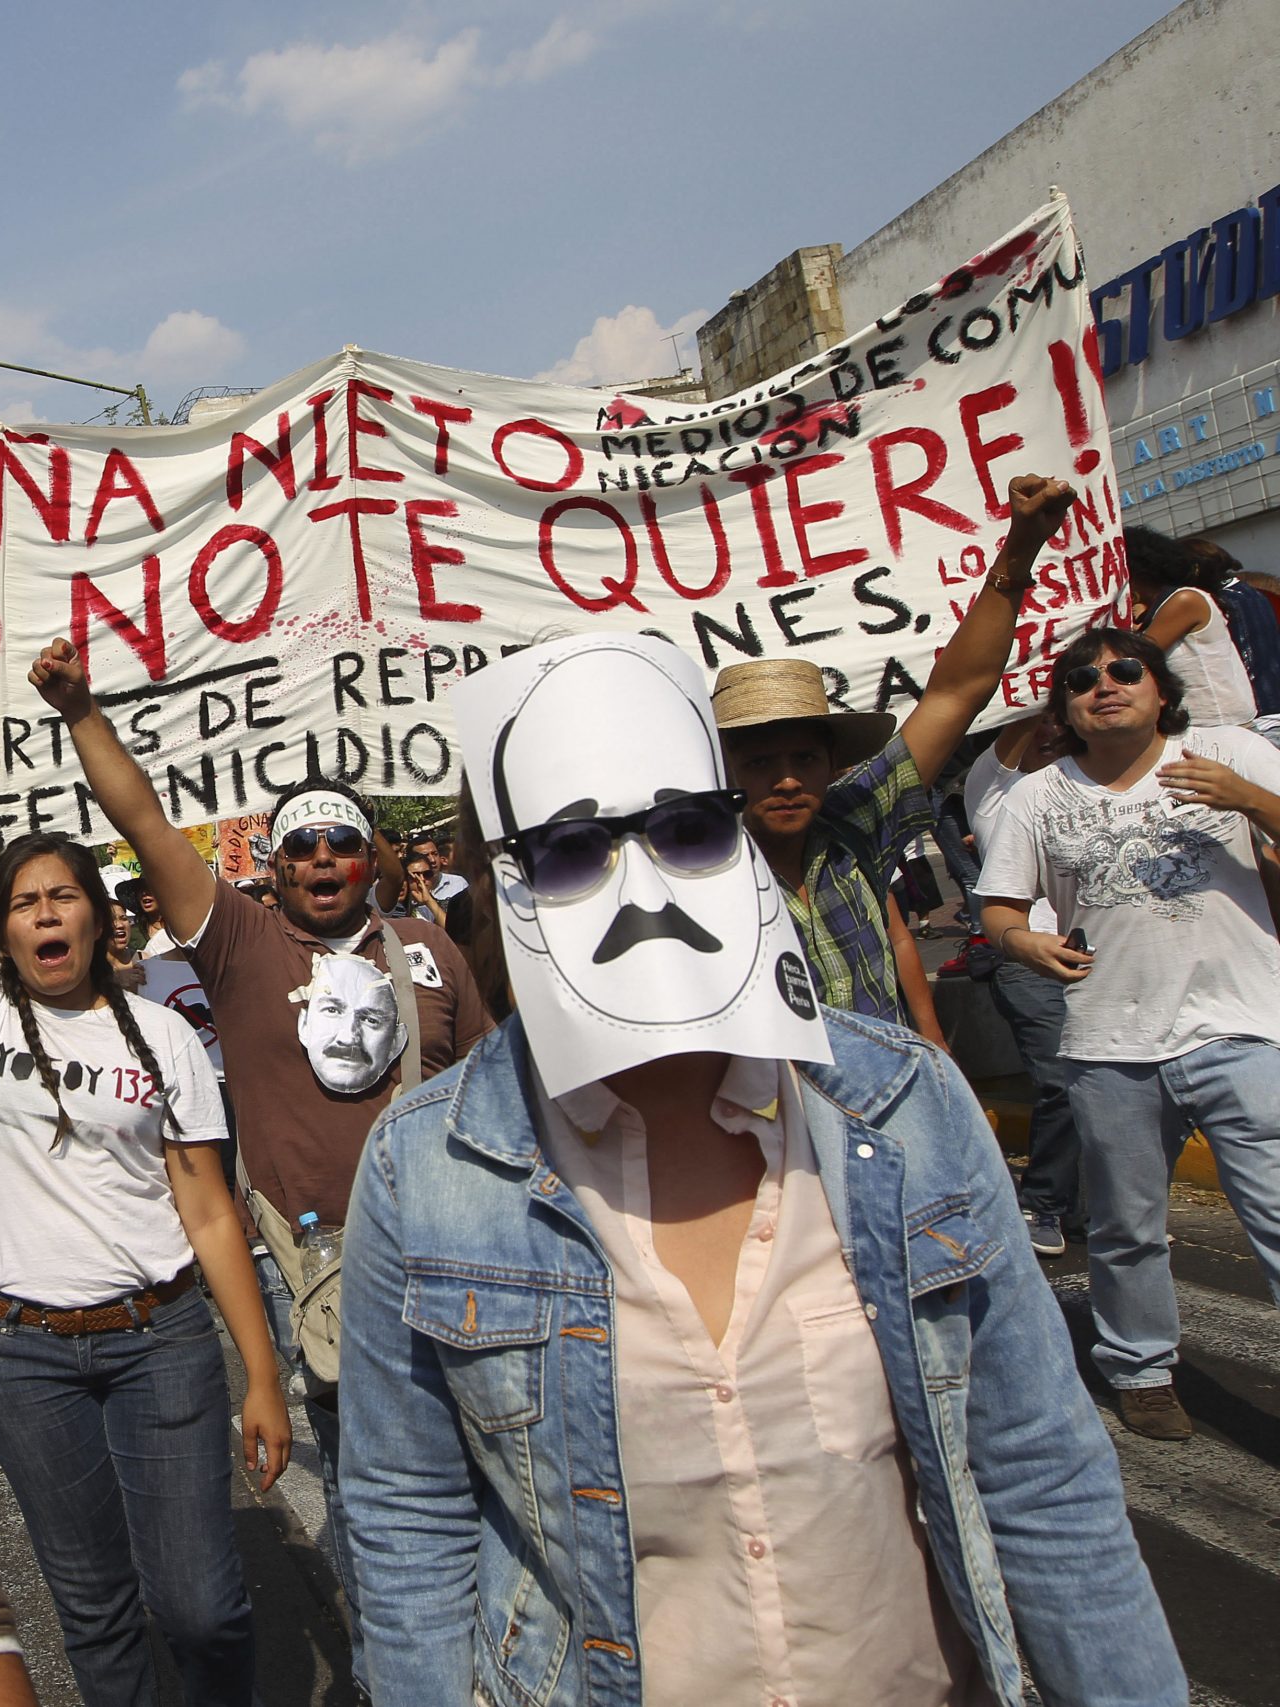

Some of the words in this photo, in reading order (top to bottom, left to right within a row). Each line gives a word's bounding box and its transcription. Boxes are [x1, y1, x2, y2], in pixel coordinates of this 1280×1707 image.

[829, 333, 911, 402] DE
[226, 379, 585, 512] NIETO
[597, 402, 862, 493] NICACION
[1134, 415, 1209, 466] ART
[70, 524, 283, 684] NO
[307, 497, 484, 623] TE
[938, 535, 1007, 586] LO
[200, 674, 287, 740] DE
[111, 1066, 161, 1109] 132
